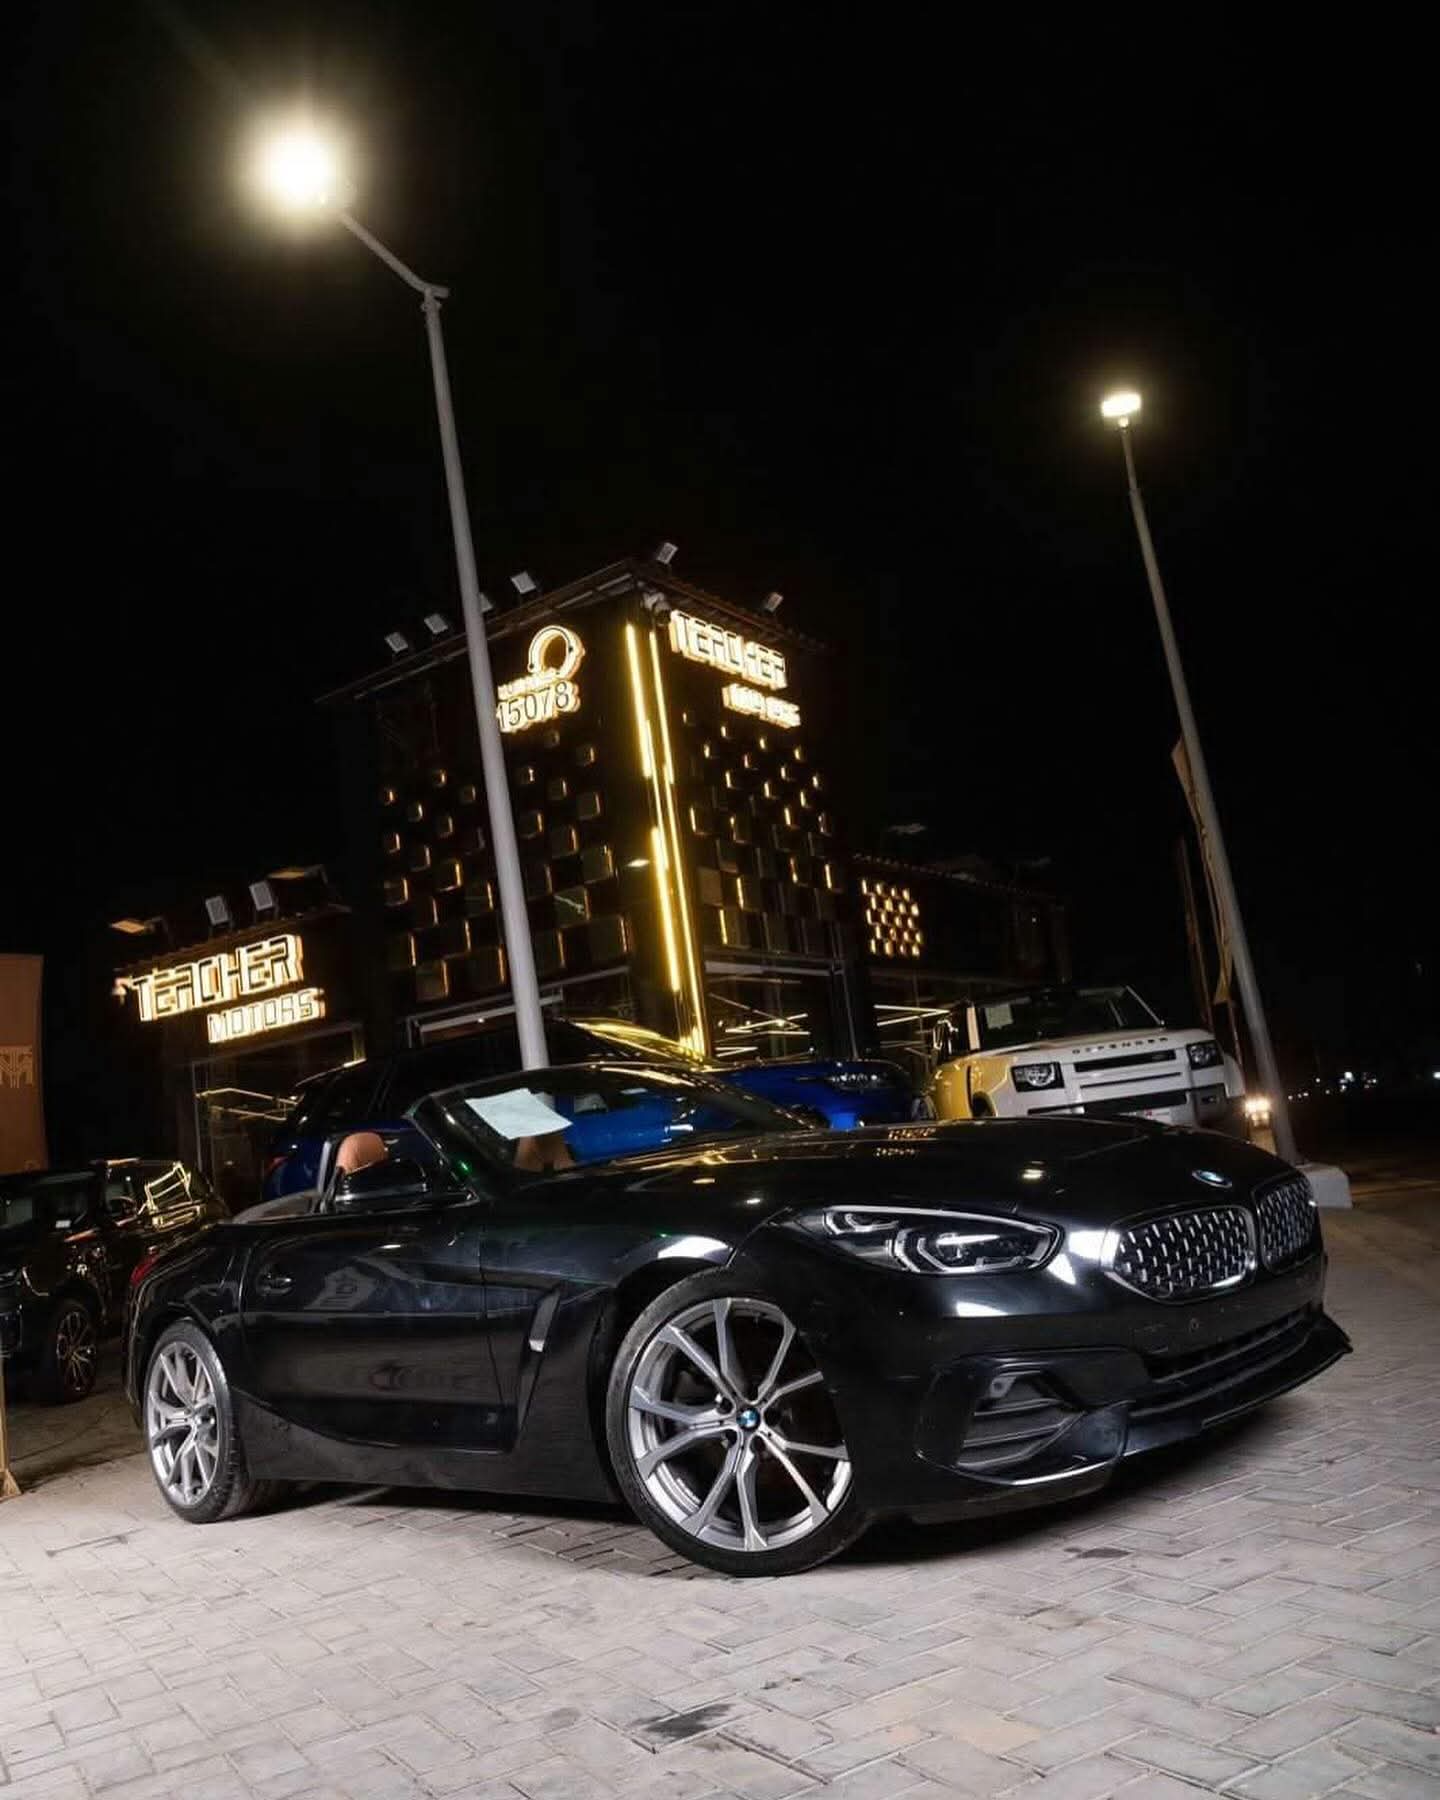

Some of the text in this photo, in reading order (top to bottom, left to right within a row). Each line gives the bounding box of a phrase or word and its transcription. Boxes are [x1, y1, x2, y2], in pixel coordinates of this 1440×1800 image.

[497, 679, 580, 733] 15078
[132, 934, 303, 1022] TEACHER
[206, 987, 325, 1044] MOTORS
